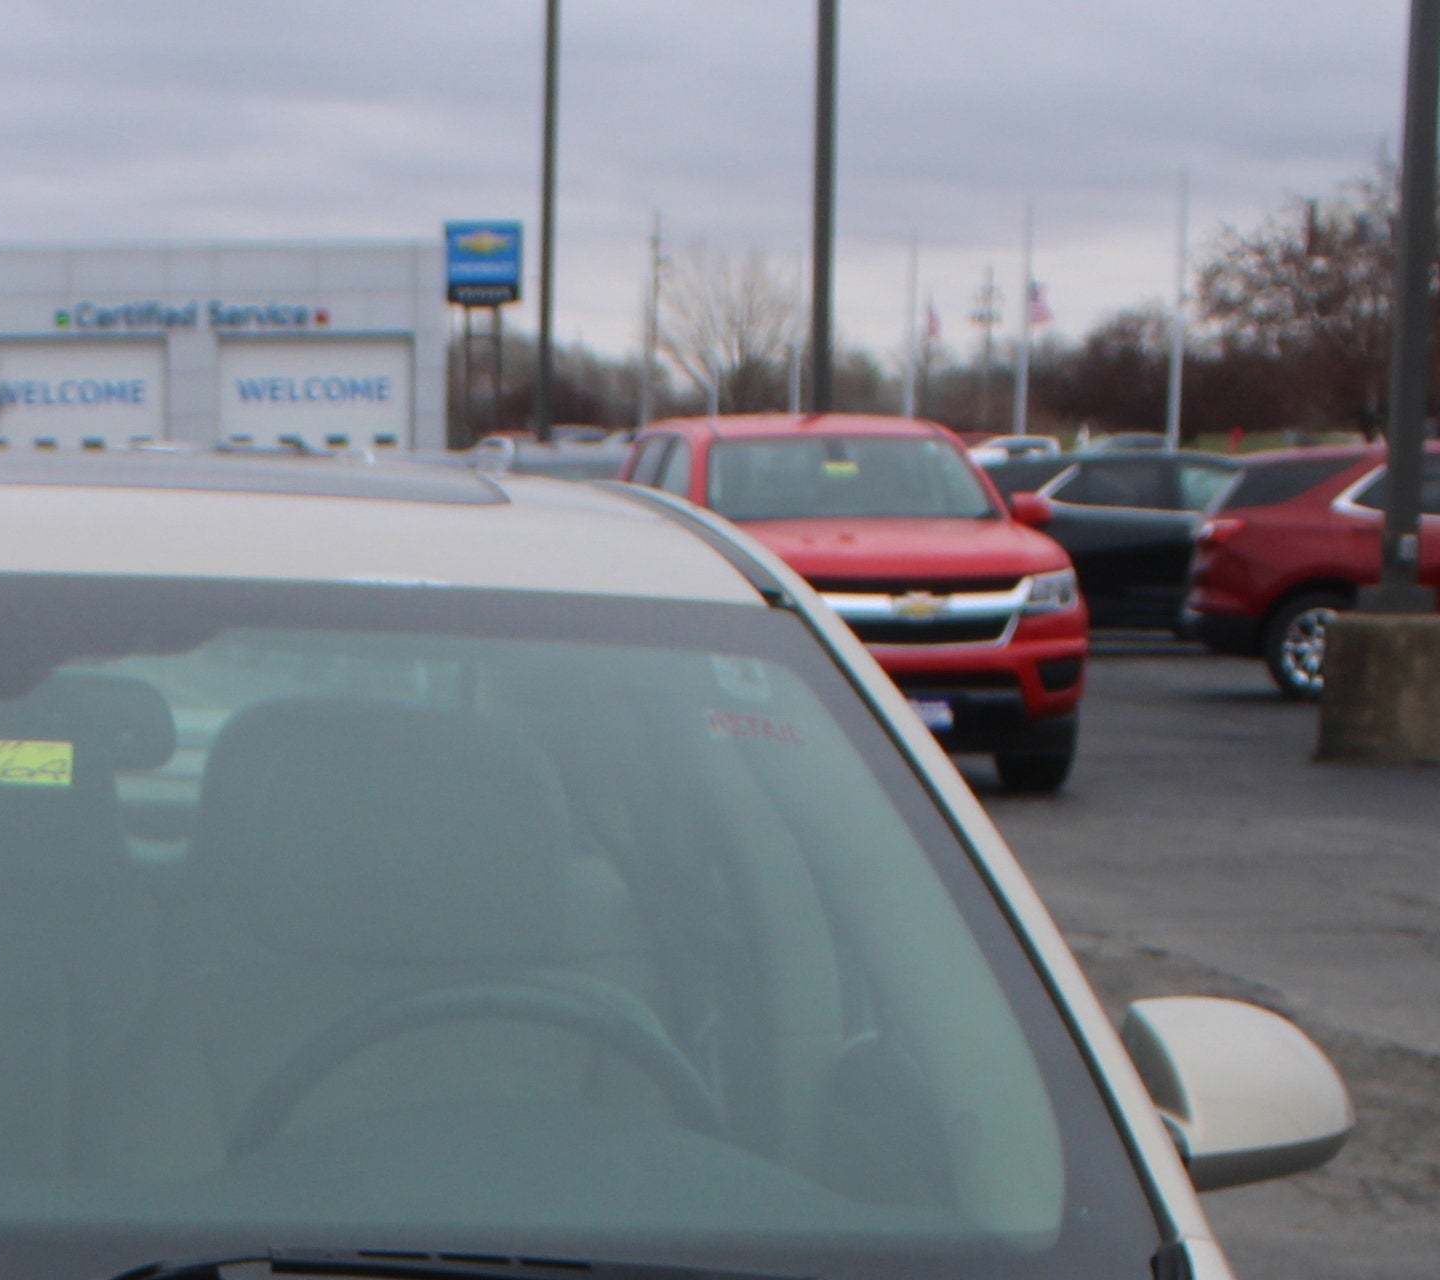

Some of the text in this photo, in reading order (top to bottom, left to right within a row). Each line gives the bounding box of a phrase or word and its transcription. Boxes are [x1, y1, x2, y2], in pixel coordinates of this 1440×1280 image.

[74, 300, 310, 328] Certified Service
[236, 376, 392, 402] WELCOME
